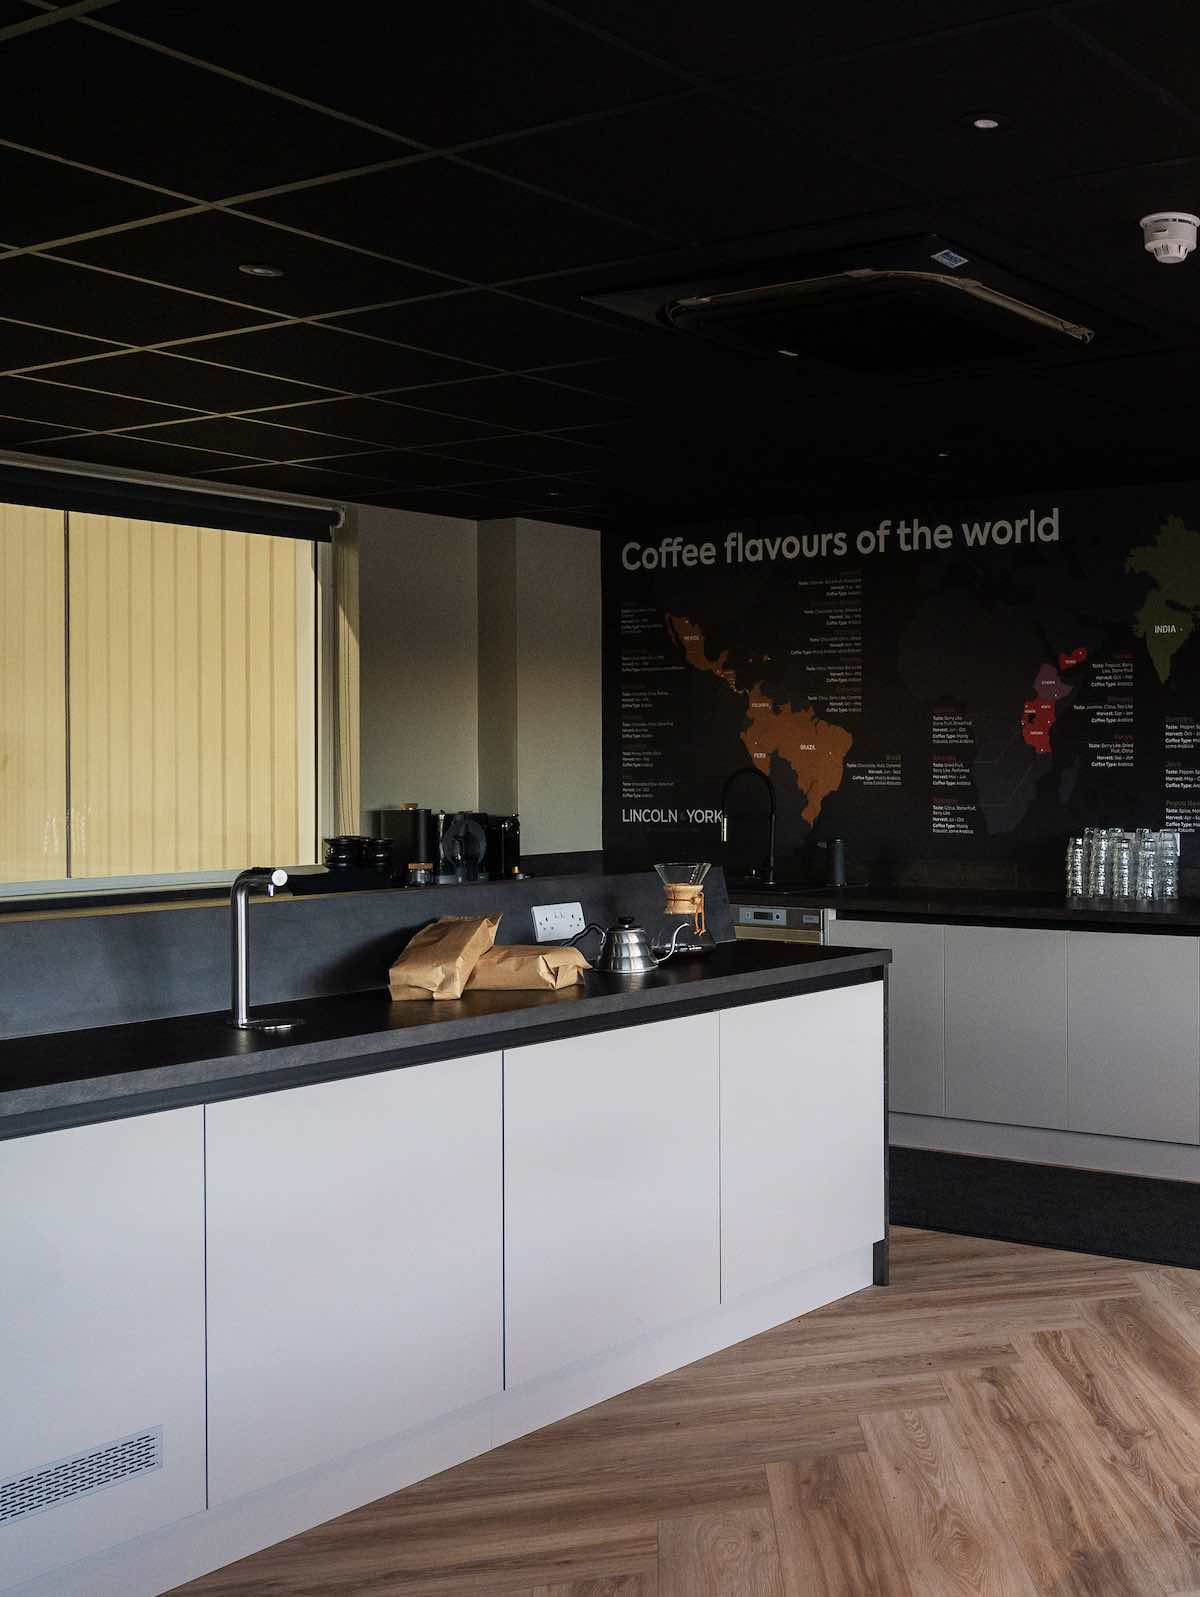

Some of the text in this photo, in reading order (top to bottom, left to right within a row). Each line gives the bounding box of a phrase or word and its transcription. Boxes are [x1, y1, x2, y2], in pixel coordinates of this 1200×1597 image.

[621, 507, 1060, 571] Coffee flavours of the world
[1154, 624, 1176, 634] INDIA
[622, 809, 723, 823] LINCOLN YORK
